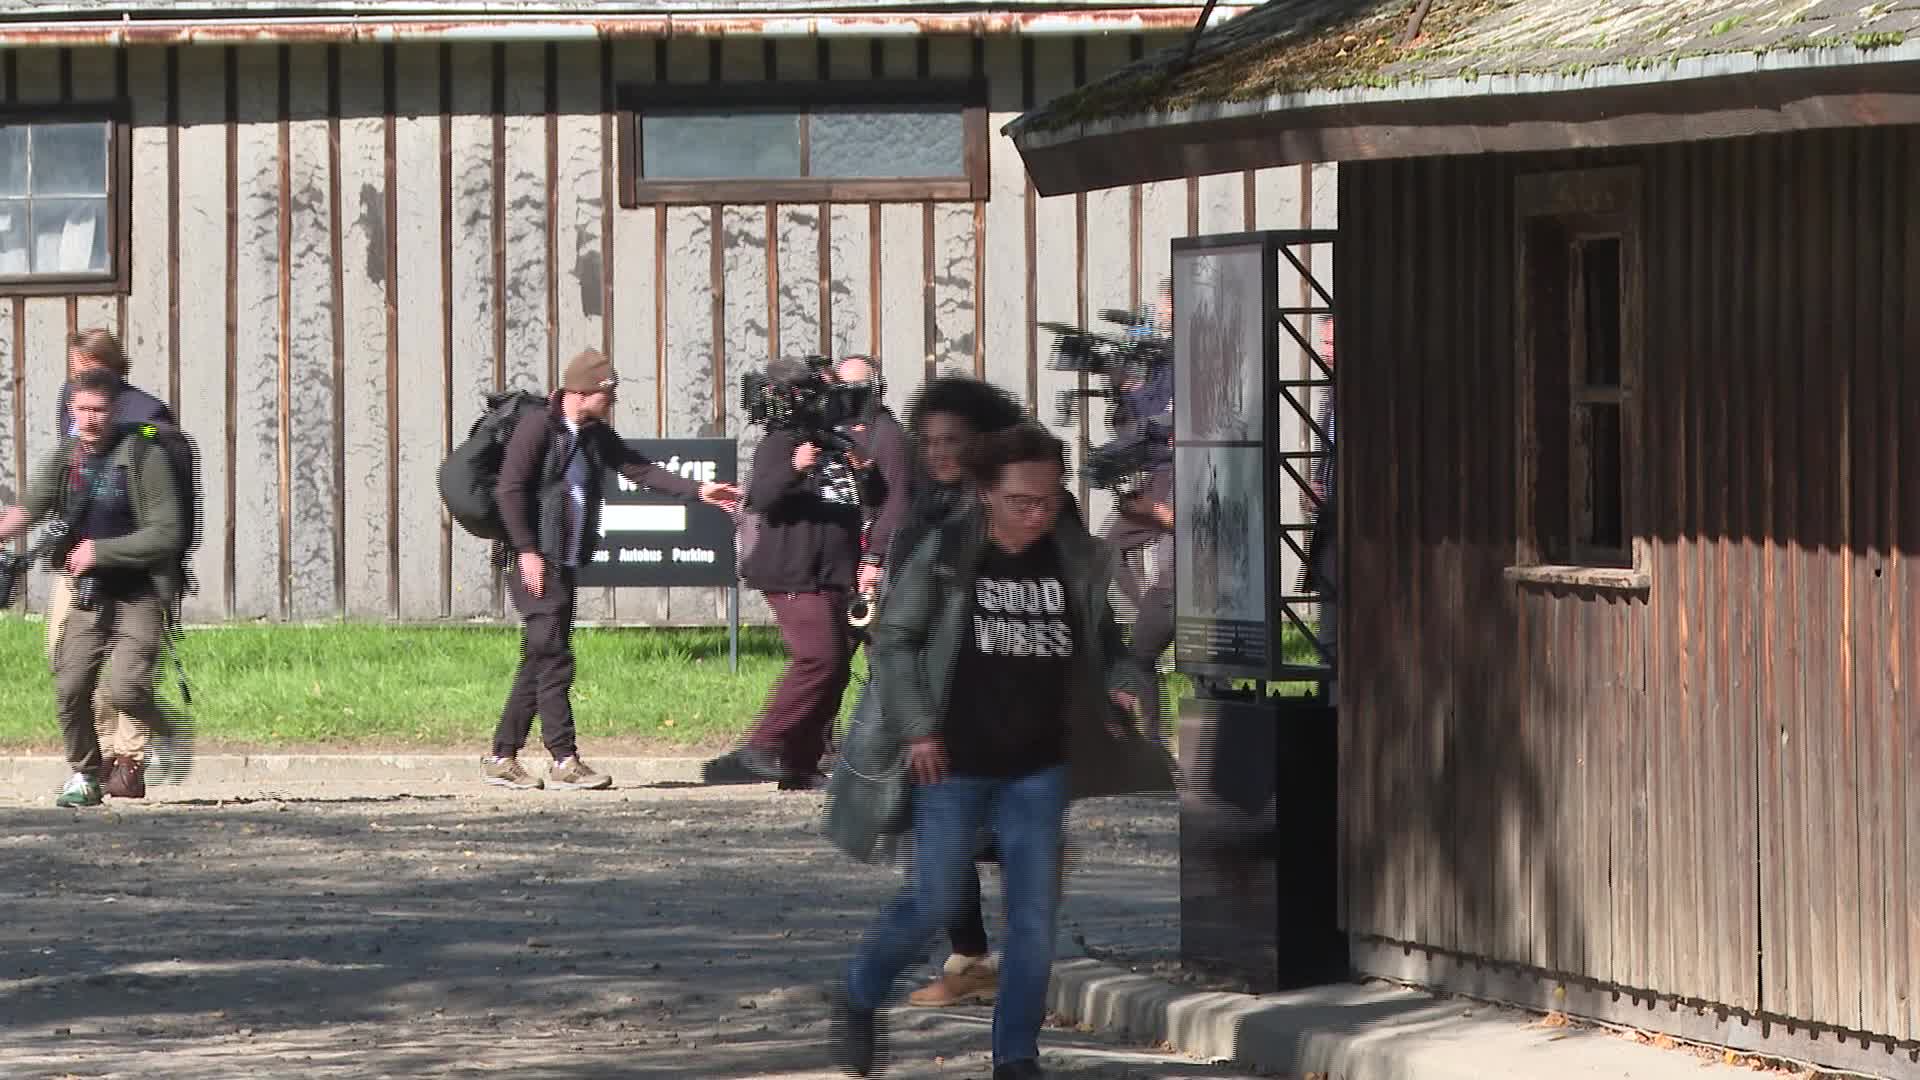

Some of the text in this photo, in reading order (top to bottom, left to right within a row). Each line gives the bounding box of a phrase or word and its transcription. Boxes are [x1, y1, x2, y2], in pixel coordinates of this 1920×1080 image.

[619, 547, 662, 562] Autobus
[672, 547, 715, 563] Parking
[976, 577, 1066, 615] GOOD
[973, 615, 1073, 657] VIBES
